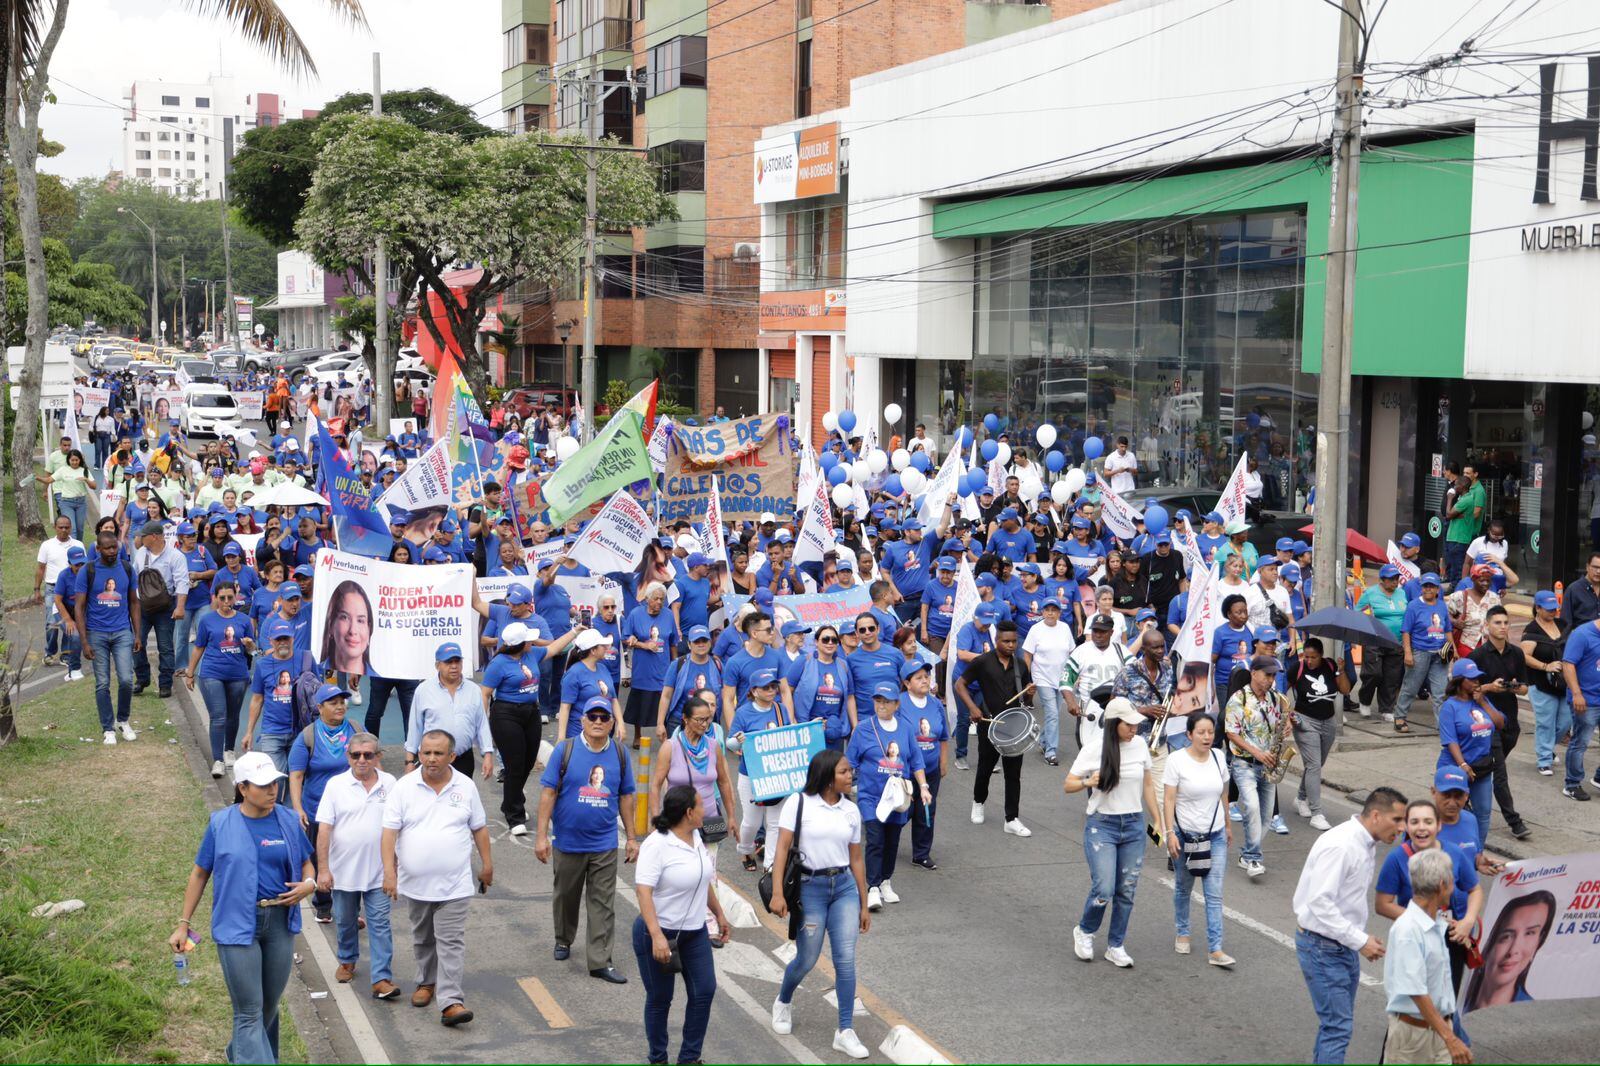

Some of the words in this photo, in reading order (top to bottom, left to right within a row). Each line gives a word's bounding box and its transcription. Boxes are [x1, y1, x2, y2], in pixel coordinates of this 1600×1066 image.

[763, 154, 793, 173] U-STORAGE
[735, 418, 764, 446] DE
[334, 475, 350, 491] UN
[586, 529, 635, 562] Miyerlandi
[321, 554, 367, 573] Miyerlandi
[378, 585, 424, 597] ¡ORDEN
[426, 585, 434, 595] Y
[378, 595, 464, 610] AUTORIDAD
[378, 617, 392, 629] LA
[395, 617, 462, 629] SUCURSAL
[412, 628, 429, 637] DEL
[431, 628, 462, 636] CIELO!
[754, 729, 798, 754] COMUNA
[797, 726, 812, 746] 18
[761, 748, 810, 774] PRESENTE
[752, 773, 791, 797] BARRIO
[1500, 864, 1568, 887] Miyerlandi
[1556, 922, 1576, 935] LA
